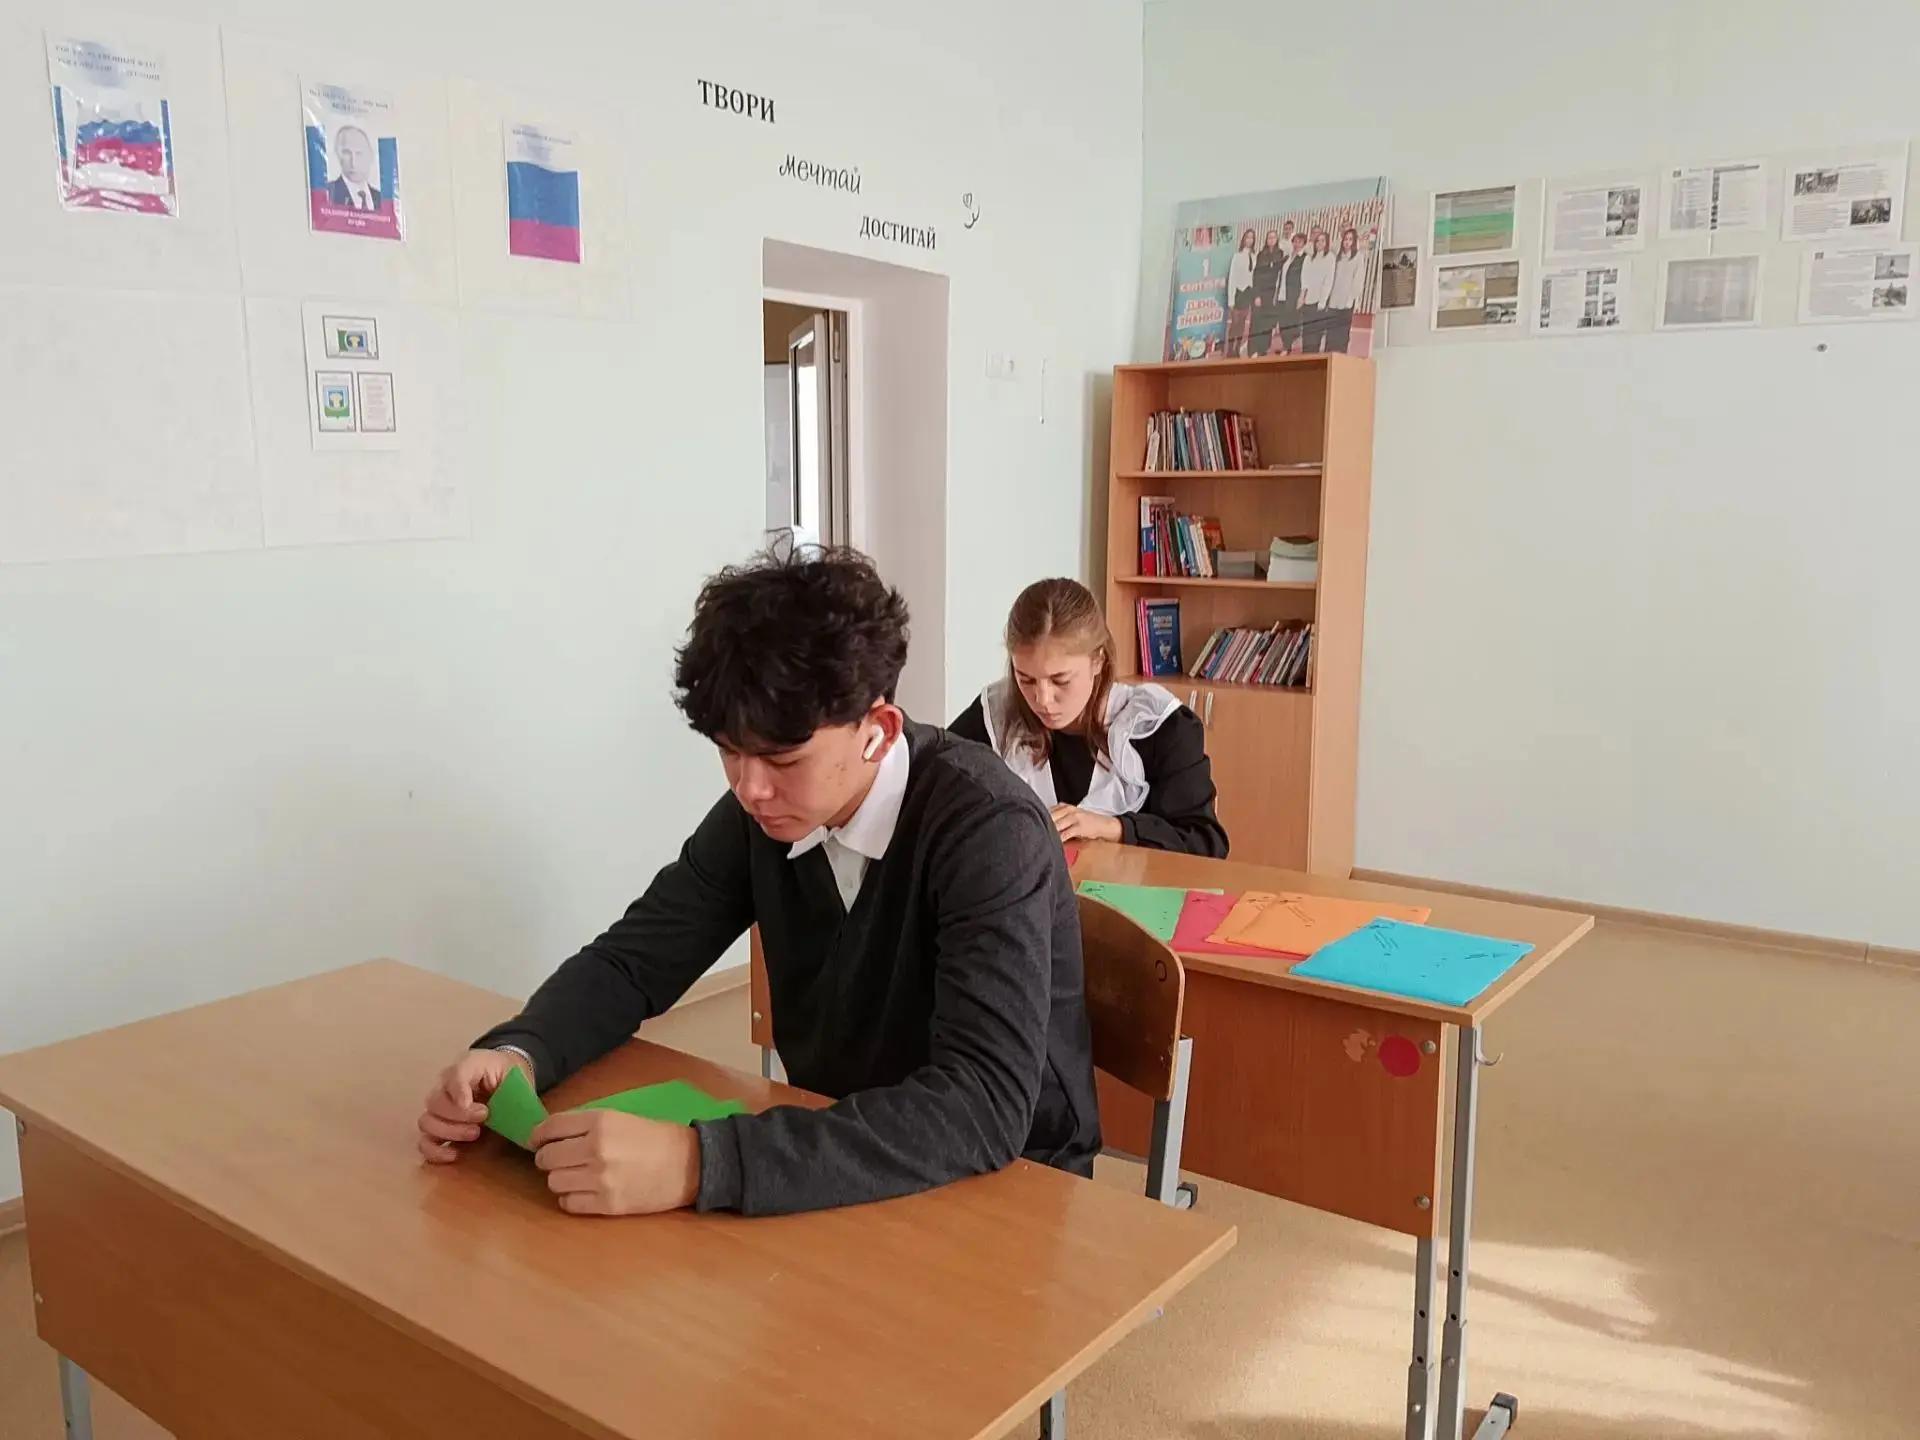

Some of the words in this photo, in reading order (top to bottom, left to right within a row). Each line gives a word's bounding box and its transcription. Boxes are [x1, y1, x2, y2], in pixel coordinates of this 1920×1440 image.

[697, 78, 775, 124] ТВОРИ
[859, 214, 937, 250] ДОСТИГАЙ
[1202, 258, 1210, 278] 1
